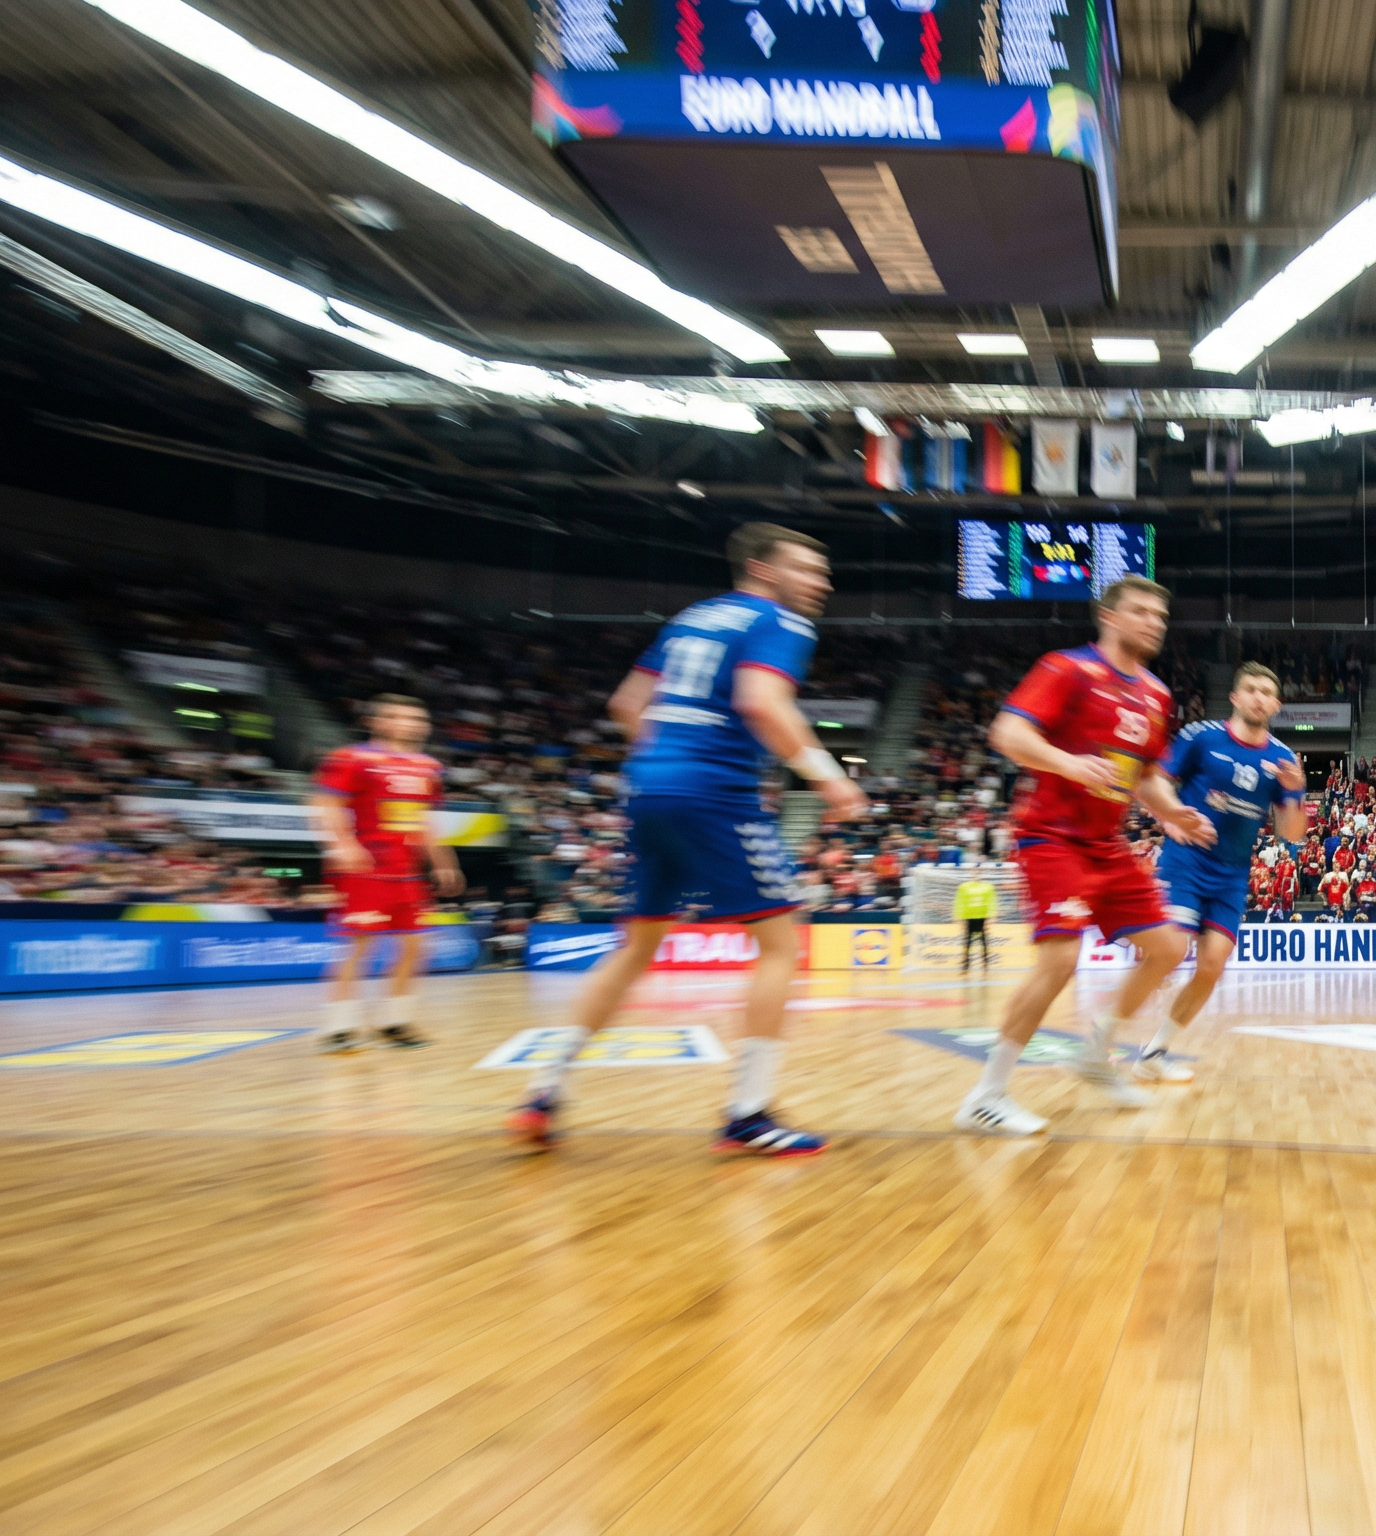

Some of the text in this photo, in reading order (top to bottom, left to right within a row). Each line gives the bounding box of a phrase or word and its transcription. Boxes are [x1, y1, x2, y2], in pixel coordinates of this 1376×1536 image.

[680, 74, 941, 141] EURO HANDBALL
[1237, 929, 1306, 962] EURO
